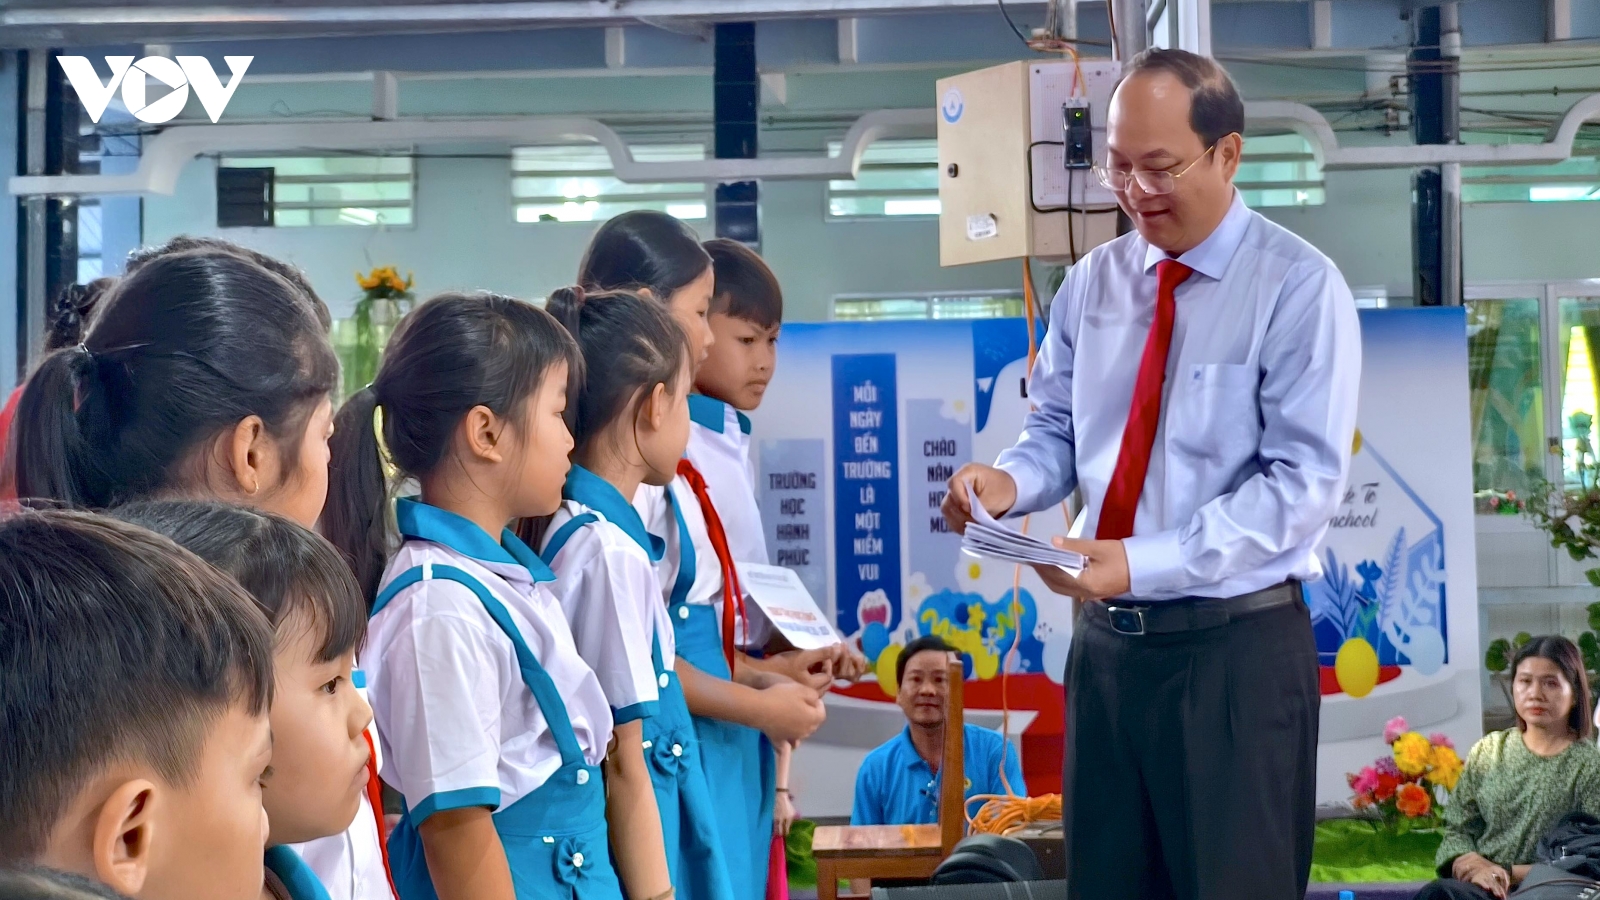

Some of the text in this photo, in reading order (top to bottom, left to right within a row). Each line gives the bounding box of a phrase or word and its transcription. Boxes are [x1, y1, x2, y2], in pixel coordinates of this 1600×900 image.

[849, 406, 882, 429] NGÀY
[854, 431, 879, 454] ĐẾN
[923, 436, 956, 457] CHÀO
[842, 458, 892, 480] TRƯỜNG
[860, 483, 875, 505] LÀ
[780, 498, 805, 518] HỌC
[855, 509, 880, 532] MỘT
[776, 523, 809, 543] HẠNH
[777, 546, 809, 566] PHÚC
[858, 563, 880, 581] VUI
